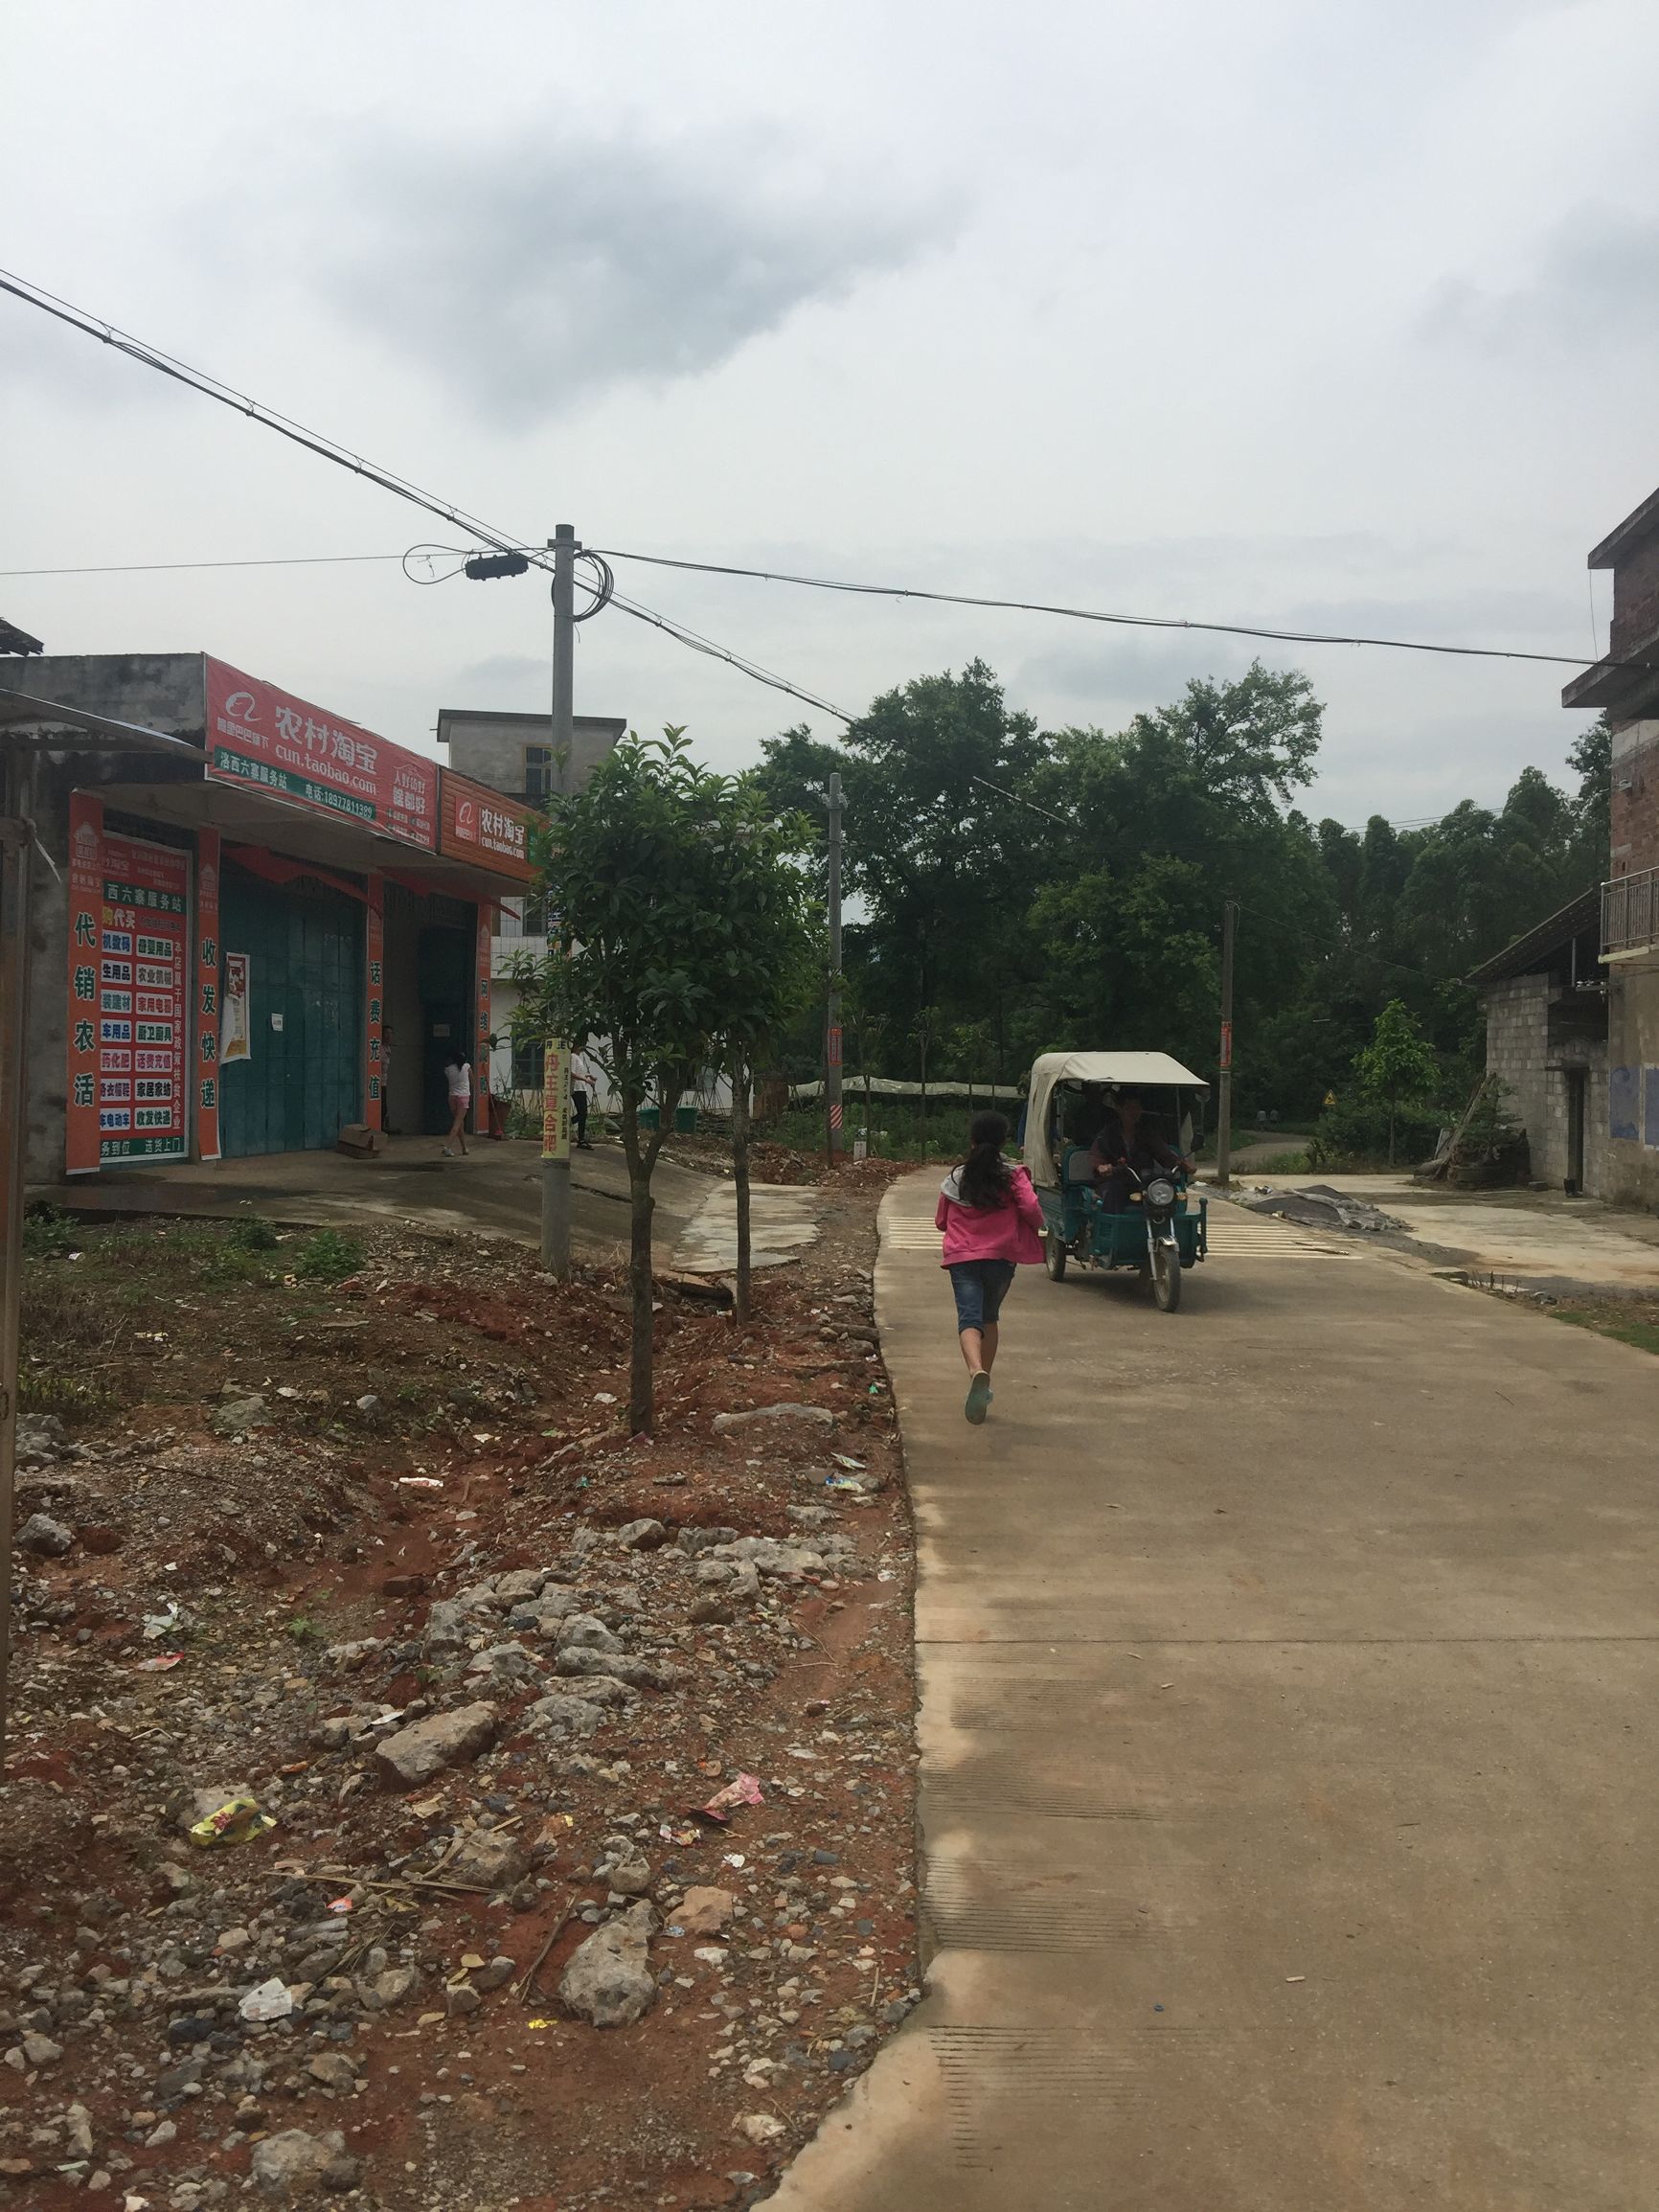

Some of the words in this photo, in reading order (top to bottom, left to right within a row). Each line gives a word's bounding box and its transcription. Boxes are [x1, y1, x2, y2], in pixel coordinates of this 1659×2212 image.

[275, 705, 378, 775] 农村淘宝
[220, 751, 288, 790] 洛西六寨服务站
[275, 744, 376, 796] cun.taobao.com
[481, 808, 525, 845] 农村淘宝
[481, 836, 525, 859] cun.taobao.com
[107, 883, 182, 913] 西六寨服务站
[102, 933, 130, 952] 机数码
[138, 938, 172, 957] 母婴用品
[102, 963, 131, 981] 生用品
[74, 911, 97, 1107] 代销农活
[138, 996, 172, 1014] 家用电器
[102, 1023, 130, 1039] 车用品
[200, 937, 216, 1108] 收发快递
[369, 961, 381, 1101] 话费充值
[137, 1025, 172, 1041] 厨卫厨具
[137, 1053, 171, 1069] 话费充值
[136, 1082, 171, 1097] 家居家纺
[136, 1110, 170, 1127] 收发快递
[145, 1137, 181, 1153] 送货上门
